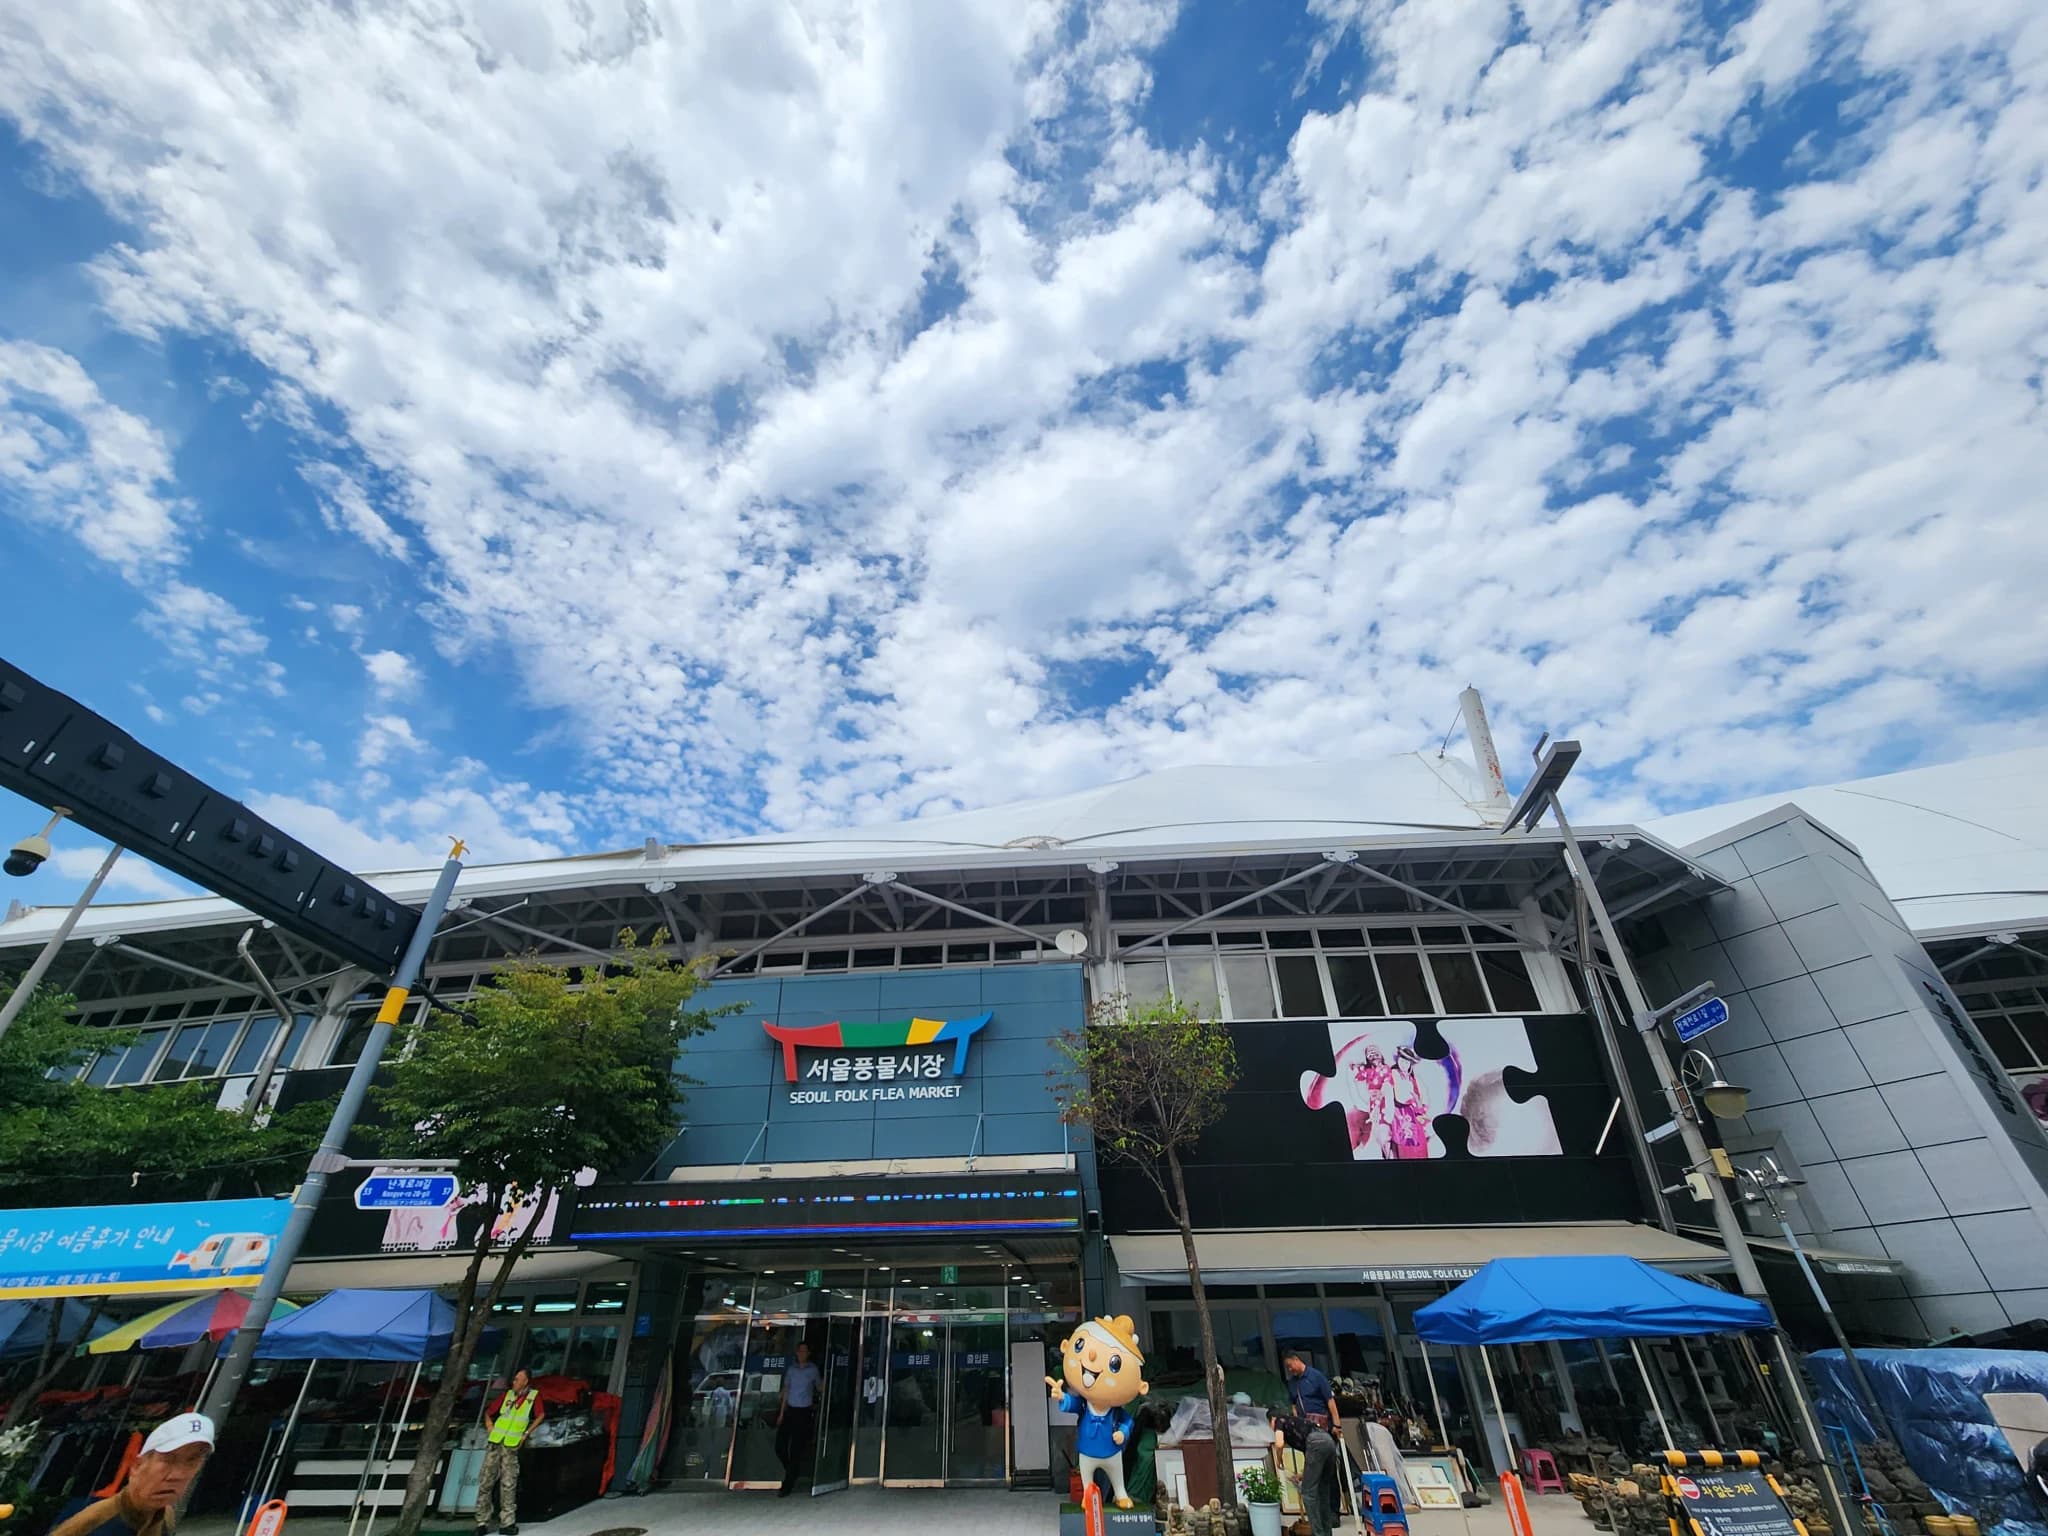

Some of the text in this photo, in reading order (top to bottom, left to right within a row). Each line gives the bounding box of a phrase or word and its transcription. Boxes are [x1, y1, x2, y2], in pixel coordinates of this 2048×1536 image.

[806, 1053, 945, 1082] 서울풍물시장
[789, 1085, 962, 1104] SEOUL FOLK FLEA MARKET
[0, 1225, 174, 1255] 물시장 여름휴가 안내
[1406, 1270, 1432, 1279] SEOUL
[1433, 1269, 1455, 1278] FOLK
[1455, 1269, 1473, 1278] FLEA
[189, 1420, 201, 1433] B
[1702, 1483, 1758, 1498] 차 없는 거리
